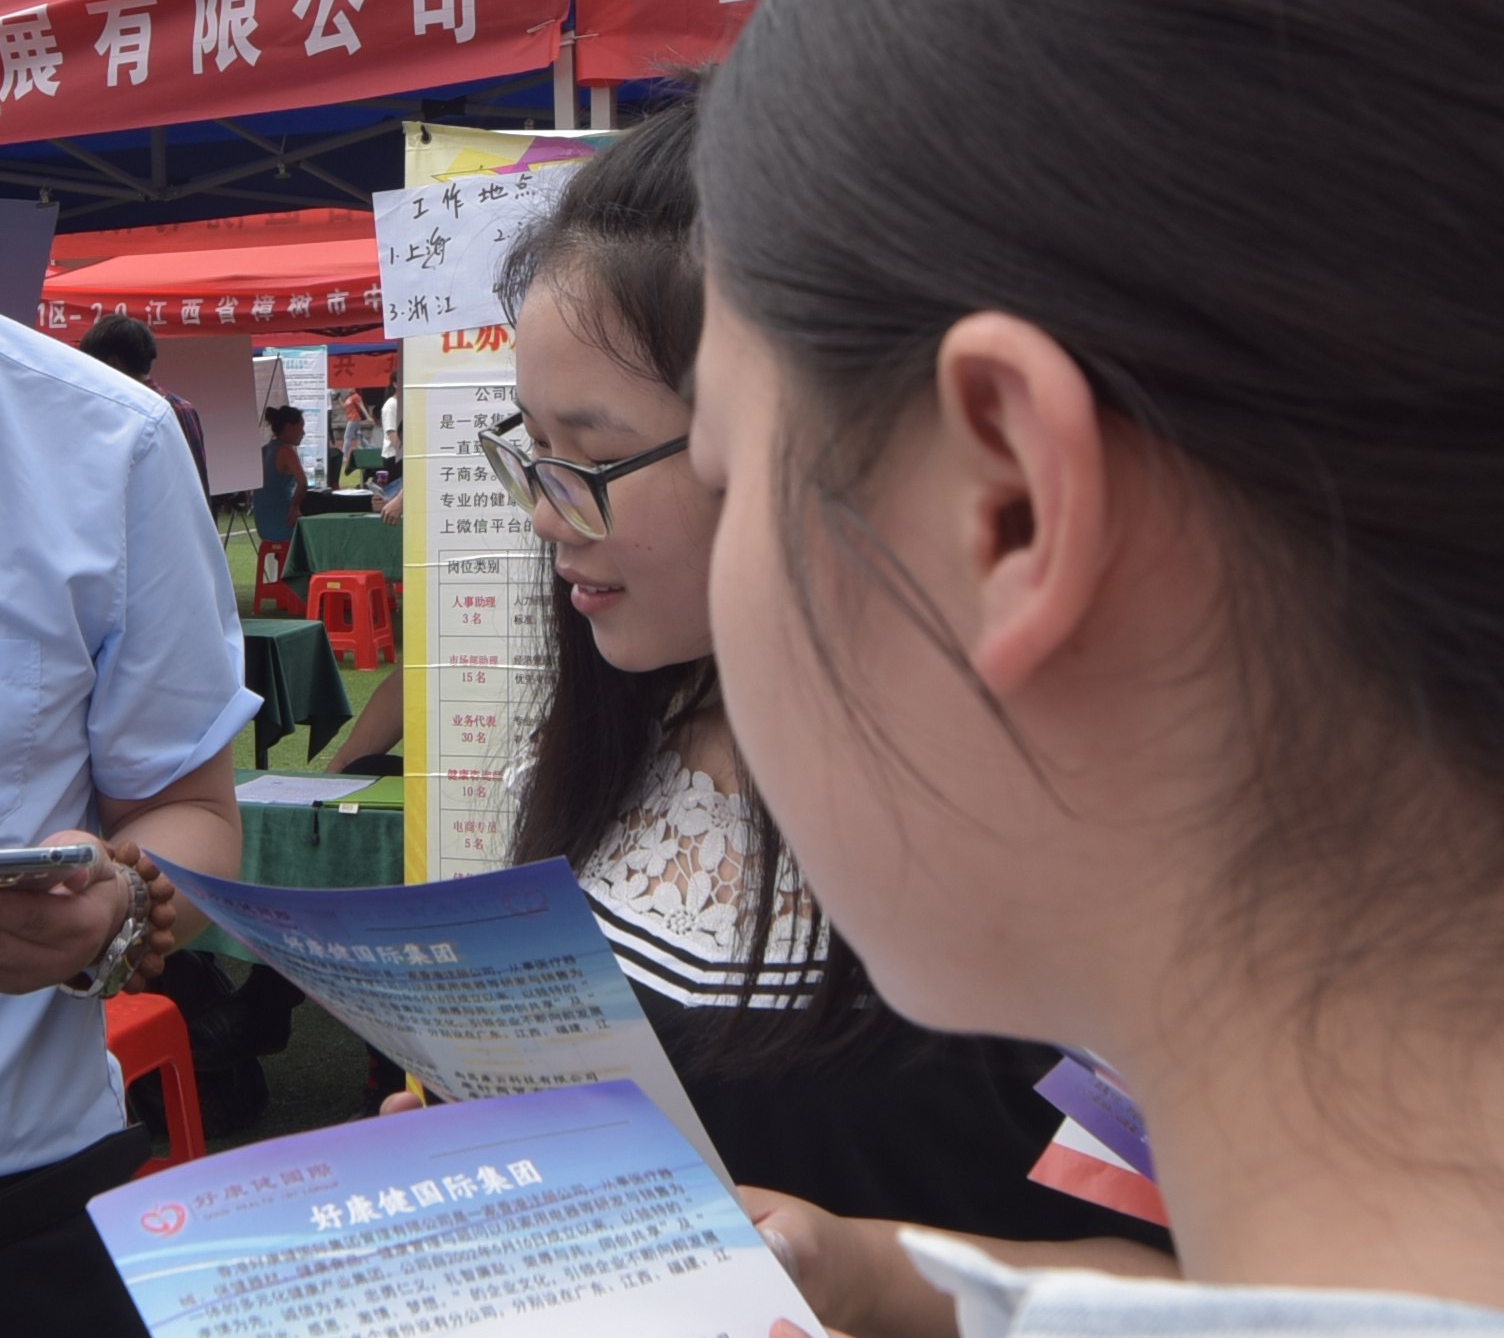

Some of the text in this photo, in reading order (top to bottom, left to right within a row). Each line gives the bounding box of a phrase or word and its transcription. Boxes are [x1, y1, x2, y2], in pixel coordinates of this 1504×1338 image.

[413, 174, 535, 219] 工作地点
[441, 324, 517, 353] 江苏
[448, 559, 499, 575] 岗位类别
[452, 596, 496, 608] 人事助理
[308, 1159, 542, 1232] 好康健国际集团
